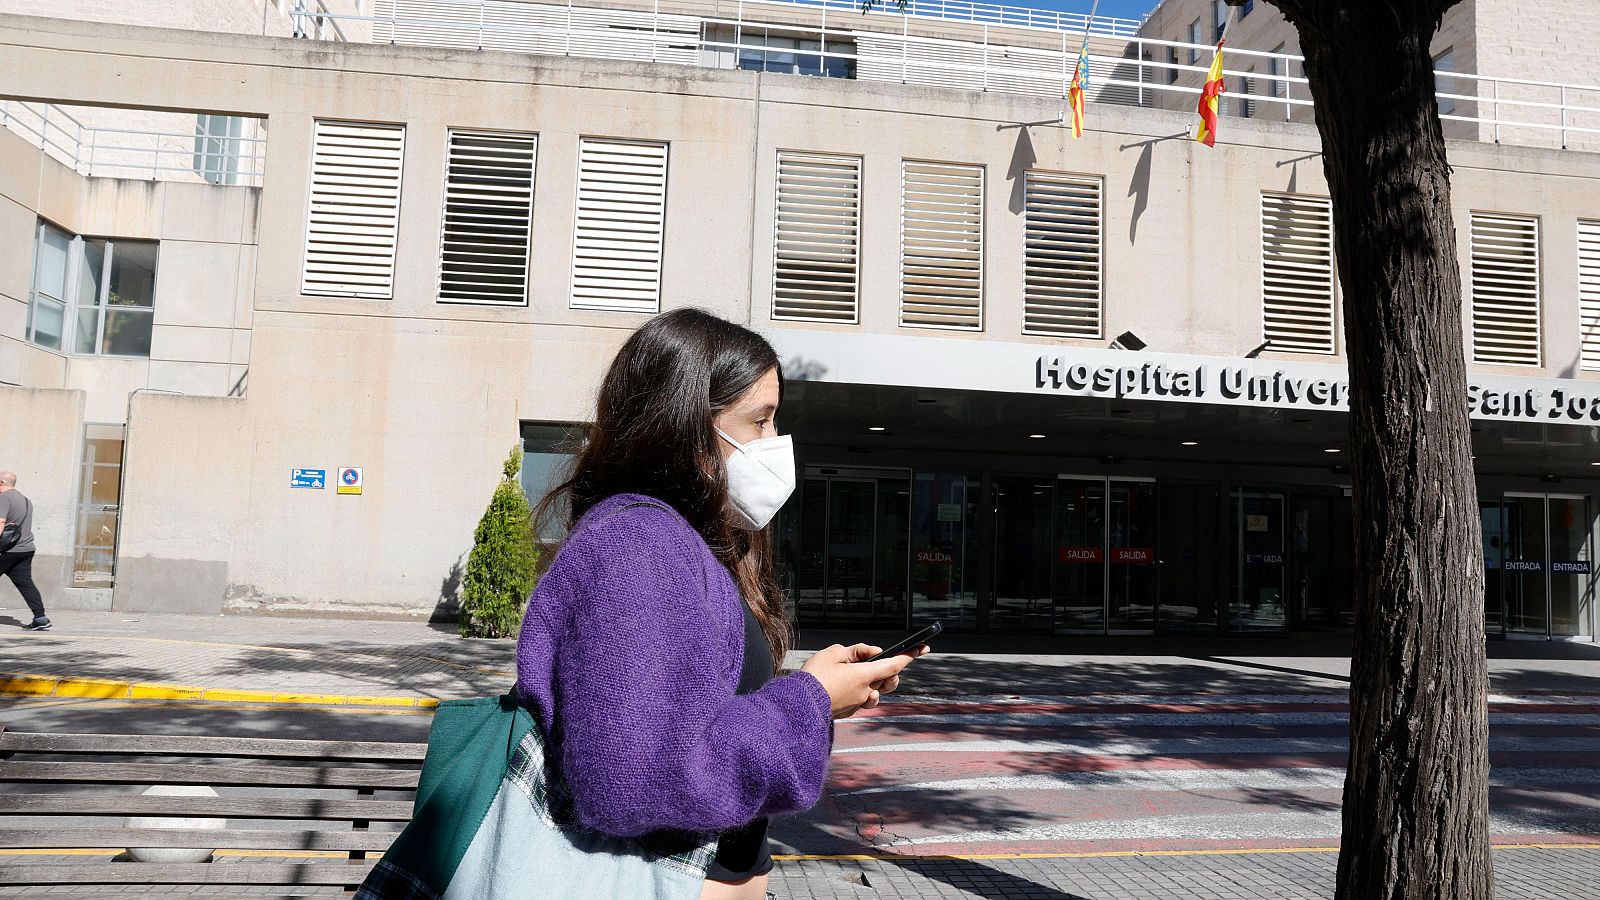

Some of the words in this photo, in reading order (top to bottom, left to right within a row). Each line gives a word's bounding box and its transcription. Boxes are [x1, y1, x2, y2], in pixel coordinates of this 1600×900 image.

[1037, 355, 1208, 397] Hospital
[1221, 366, 1349, 404] Univer
[1468, 384, 1542, 417] Sant
[292, 469, 302, 479] P
[917, 552, 952, 562] SALIDA
[1067, 550, 1096, 559] SALIDA
[1119, 551, 1147, 560] SALIDA
[1505, 561, 1541, 571] ENTRADA
[1553, 562, 1589, 571] ENTRADA
